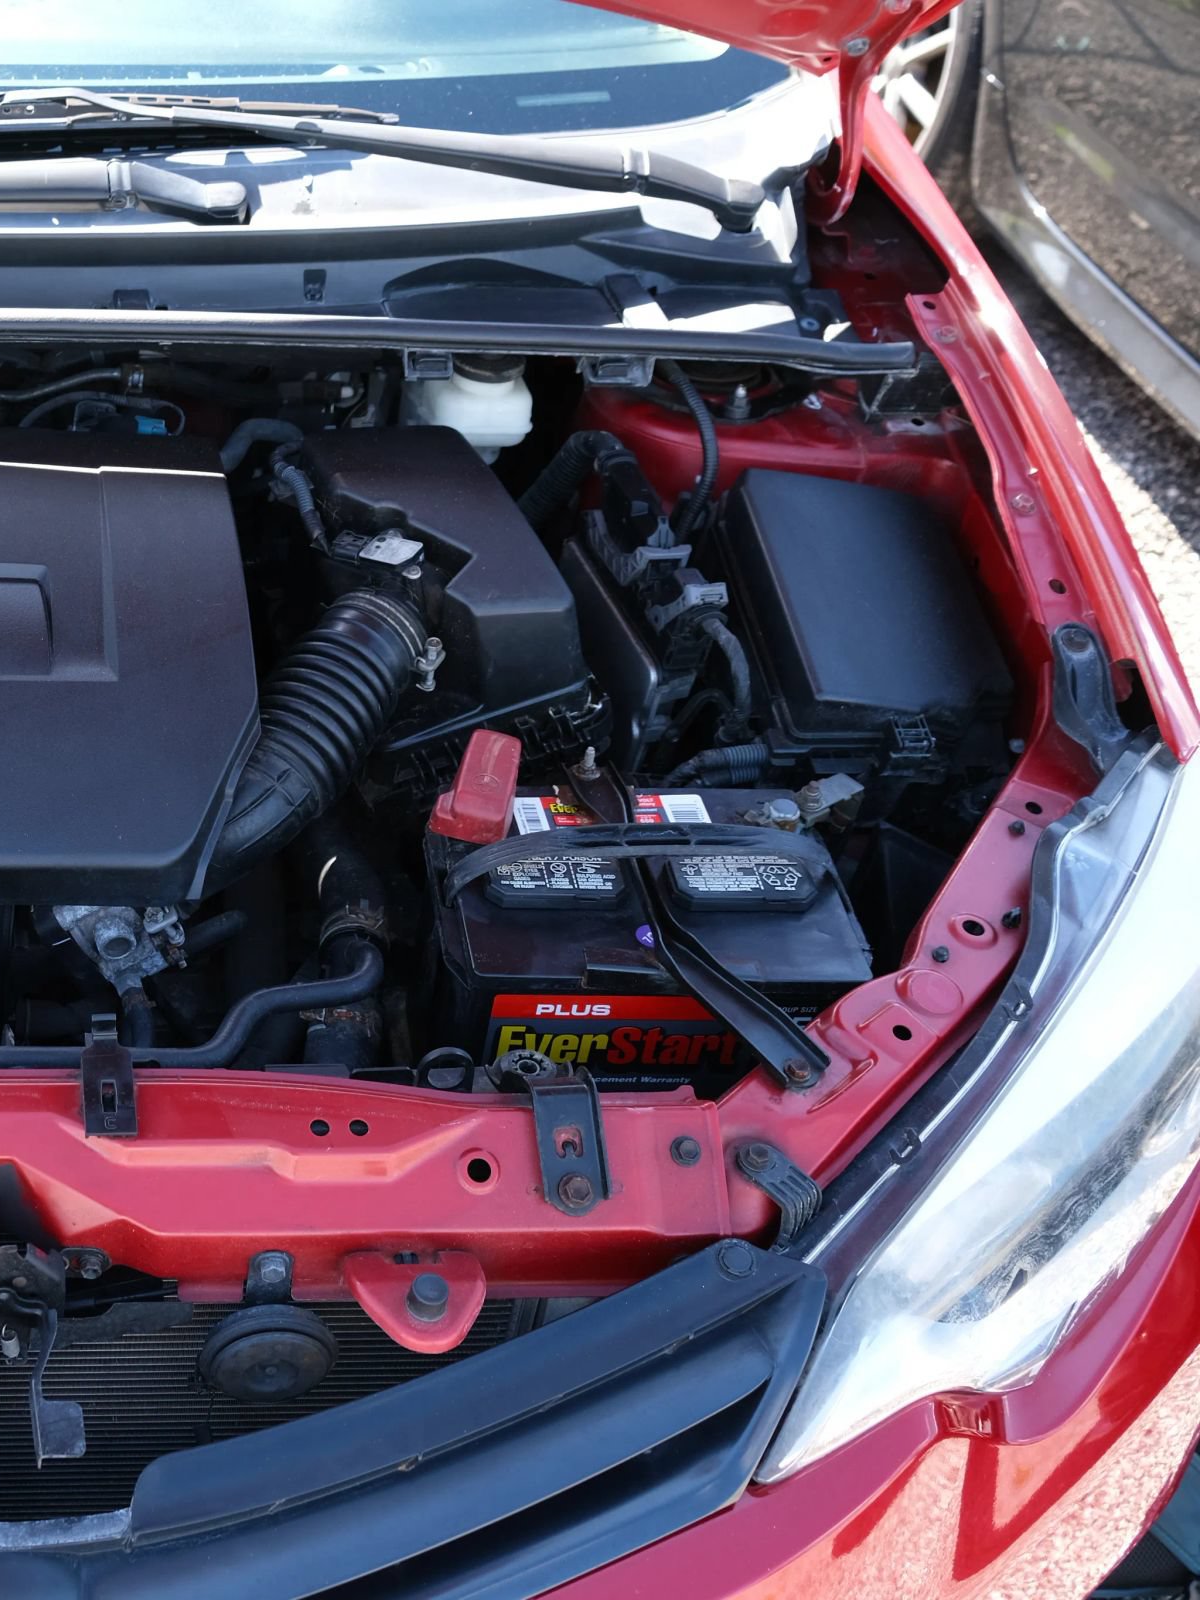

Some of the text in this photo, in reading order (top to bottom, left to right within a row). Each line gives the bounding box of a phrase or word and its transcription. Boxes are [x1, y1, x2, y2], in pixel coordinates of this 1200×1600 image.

[535, 1003, 612, 1016] PLUS
[497, 1025, 740, 1066] EverStart
[641, 1076, 691, 1084] Warranty
